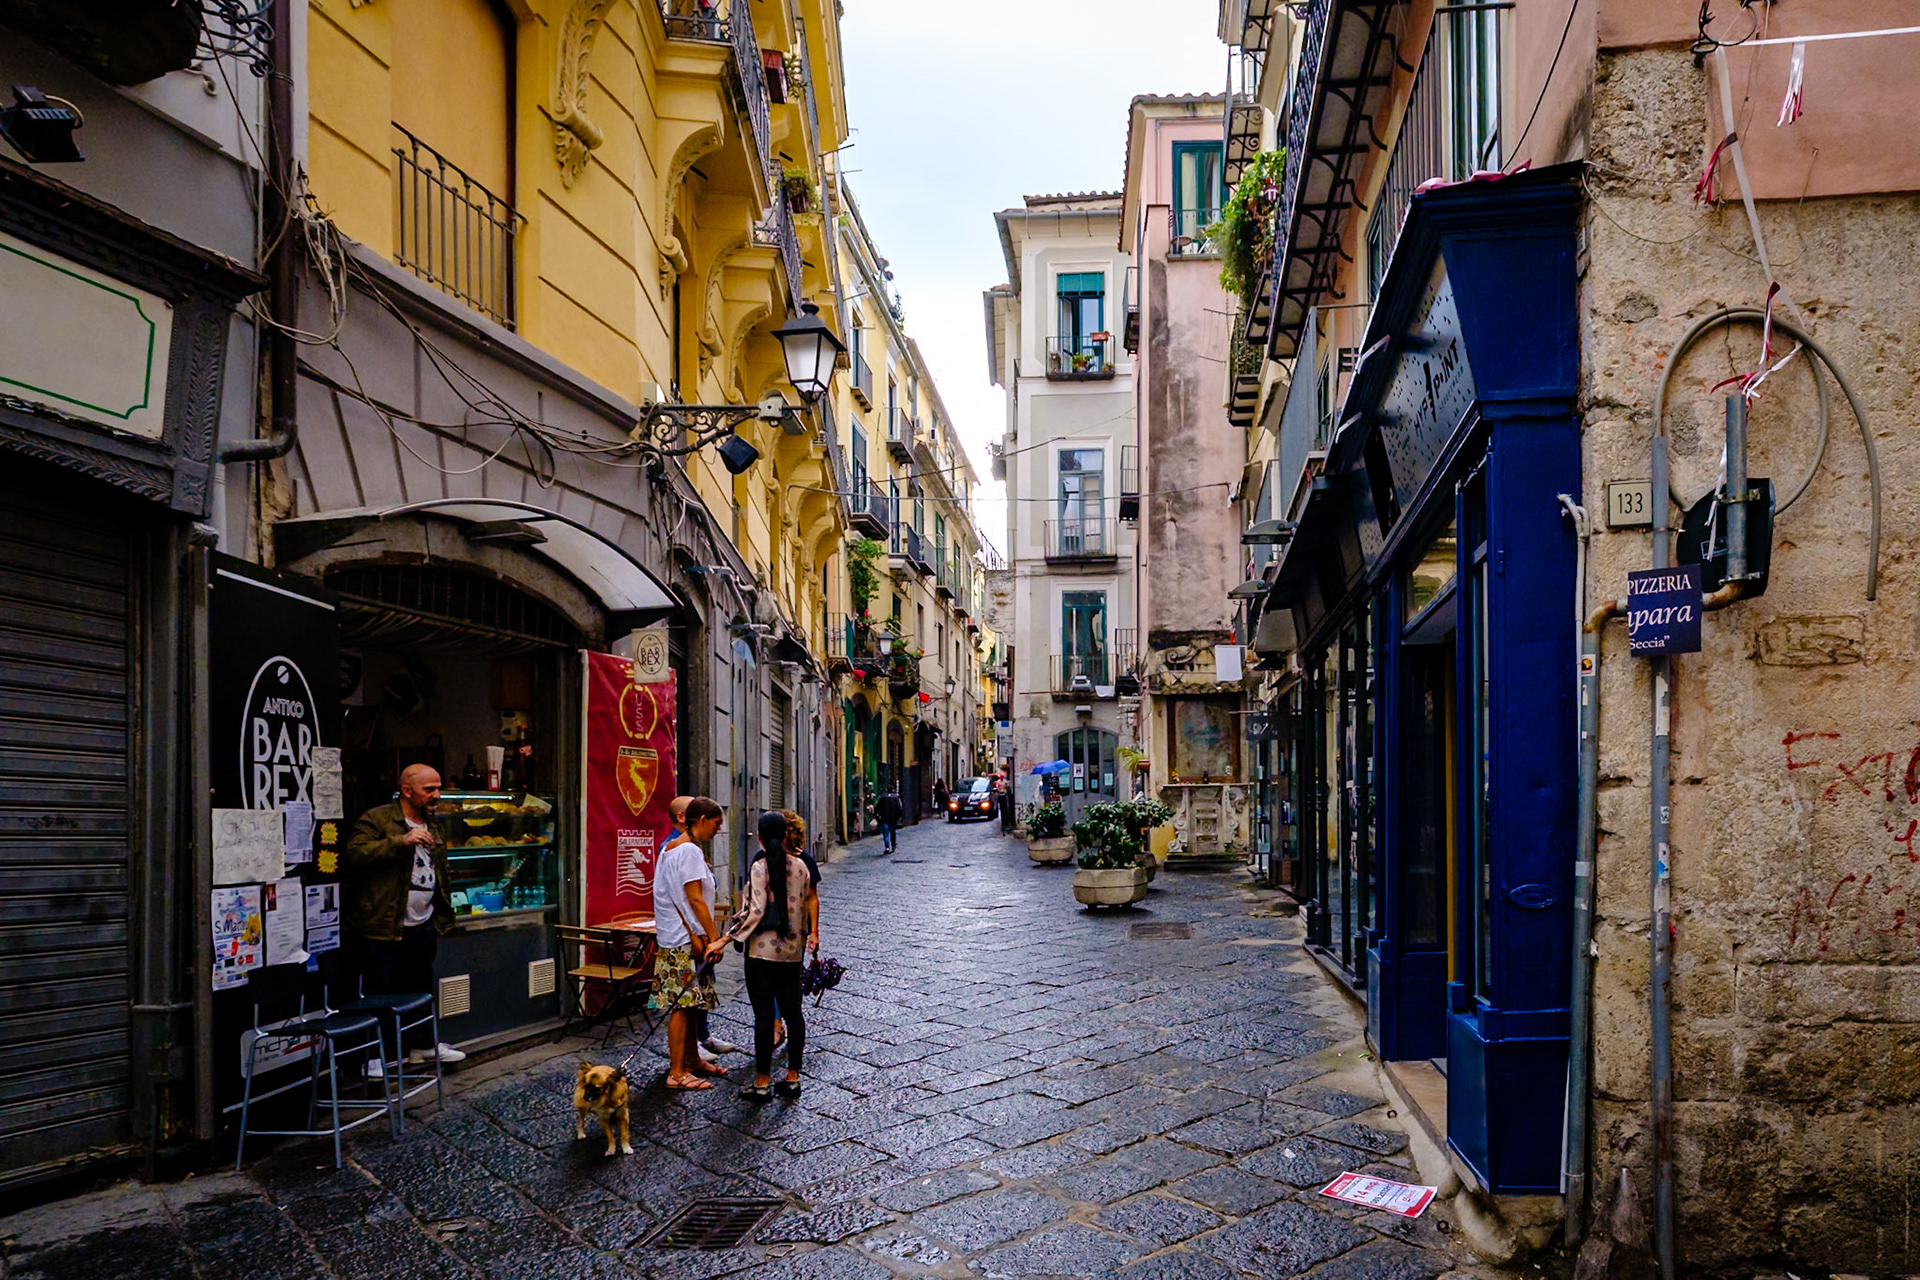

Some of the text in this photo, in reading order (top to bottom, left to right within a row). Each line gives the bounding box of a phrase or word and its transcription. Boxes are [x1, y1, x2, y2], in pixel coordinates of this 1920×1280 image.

[1618, 492, 1643, 514] 133
[1627, 574, 1692, 595] PIZZERIA
[641, 647, 660, 656] BAR
[641, 655, 660, 666] REX
[263, 697, 304, 718] ANTICO
[253, 717, 313, 767] BAR
[253, 763, 313, 812] REX
[618, 838, 653, 846] SALERNITANA
